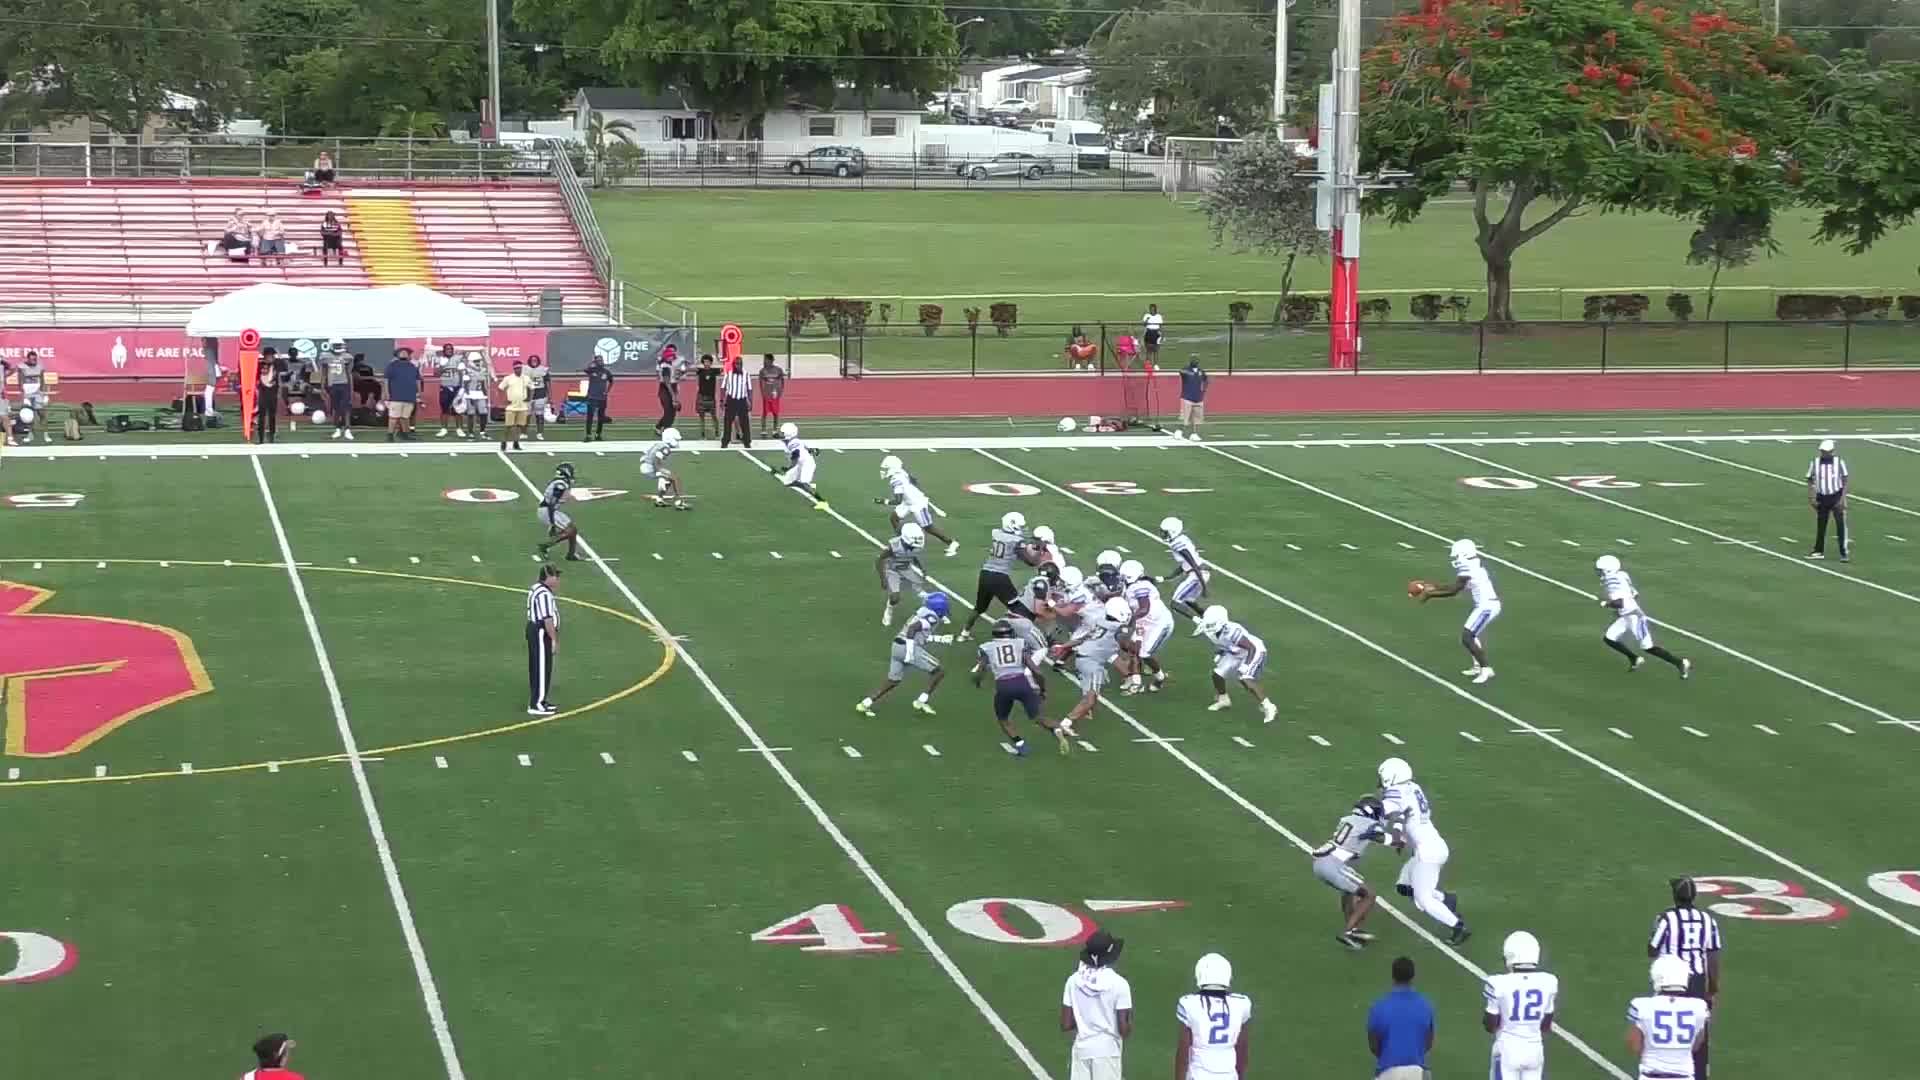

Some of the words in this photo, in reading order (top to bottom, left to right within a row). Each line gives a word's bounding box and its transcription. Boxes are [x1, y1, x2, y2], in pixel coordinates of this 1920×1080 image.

[135, 347, 154, 358] WE
[156, 347, 180, 358] ARE
[183, 347, 206, 358] PAC
[491, 347, 520, 357] PACE
[624, 341, 649, 351] ONE
[624, 351, 639, 361] FC
[996, 643, 1016, 664] 18
[1681, 921, 1703, 949] H
[1509, 988, 1543, 1021] 12
[1208, 1012, 1230, 1044] 2
[1653, 1010, 1695, 1044] 55
